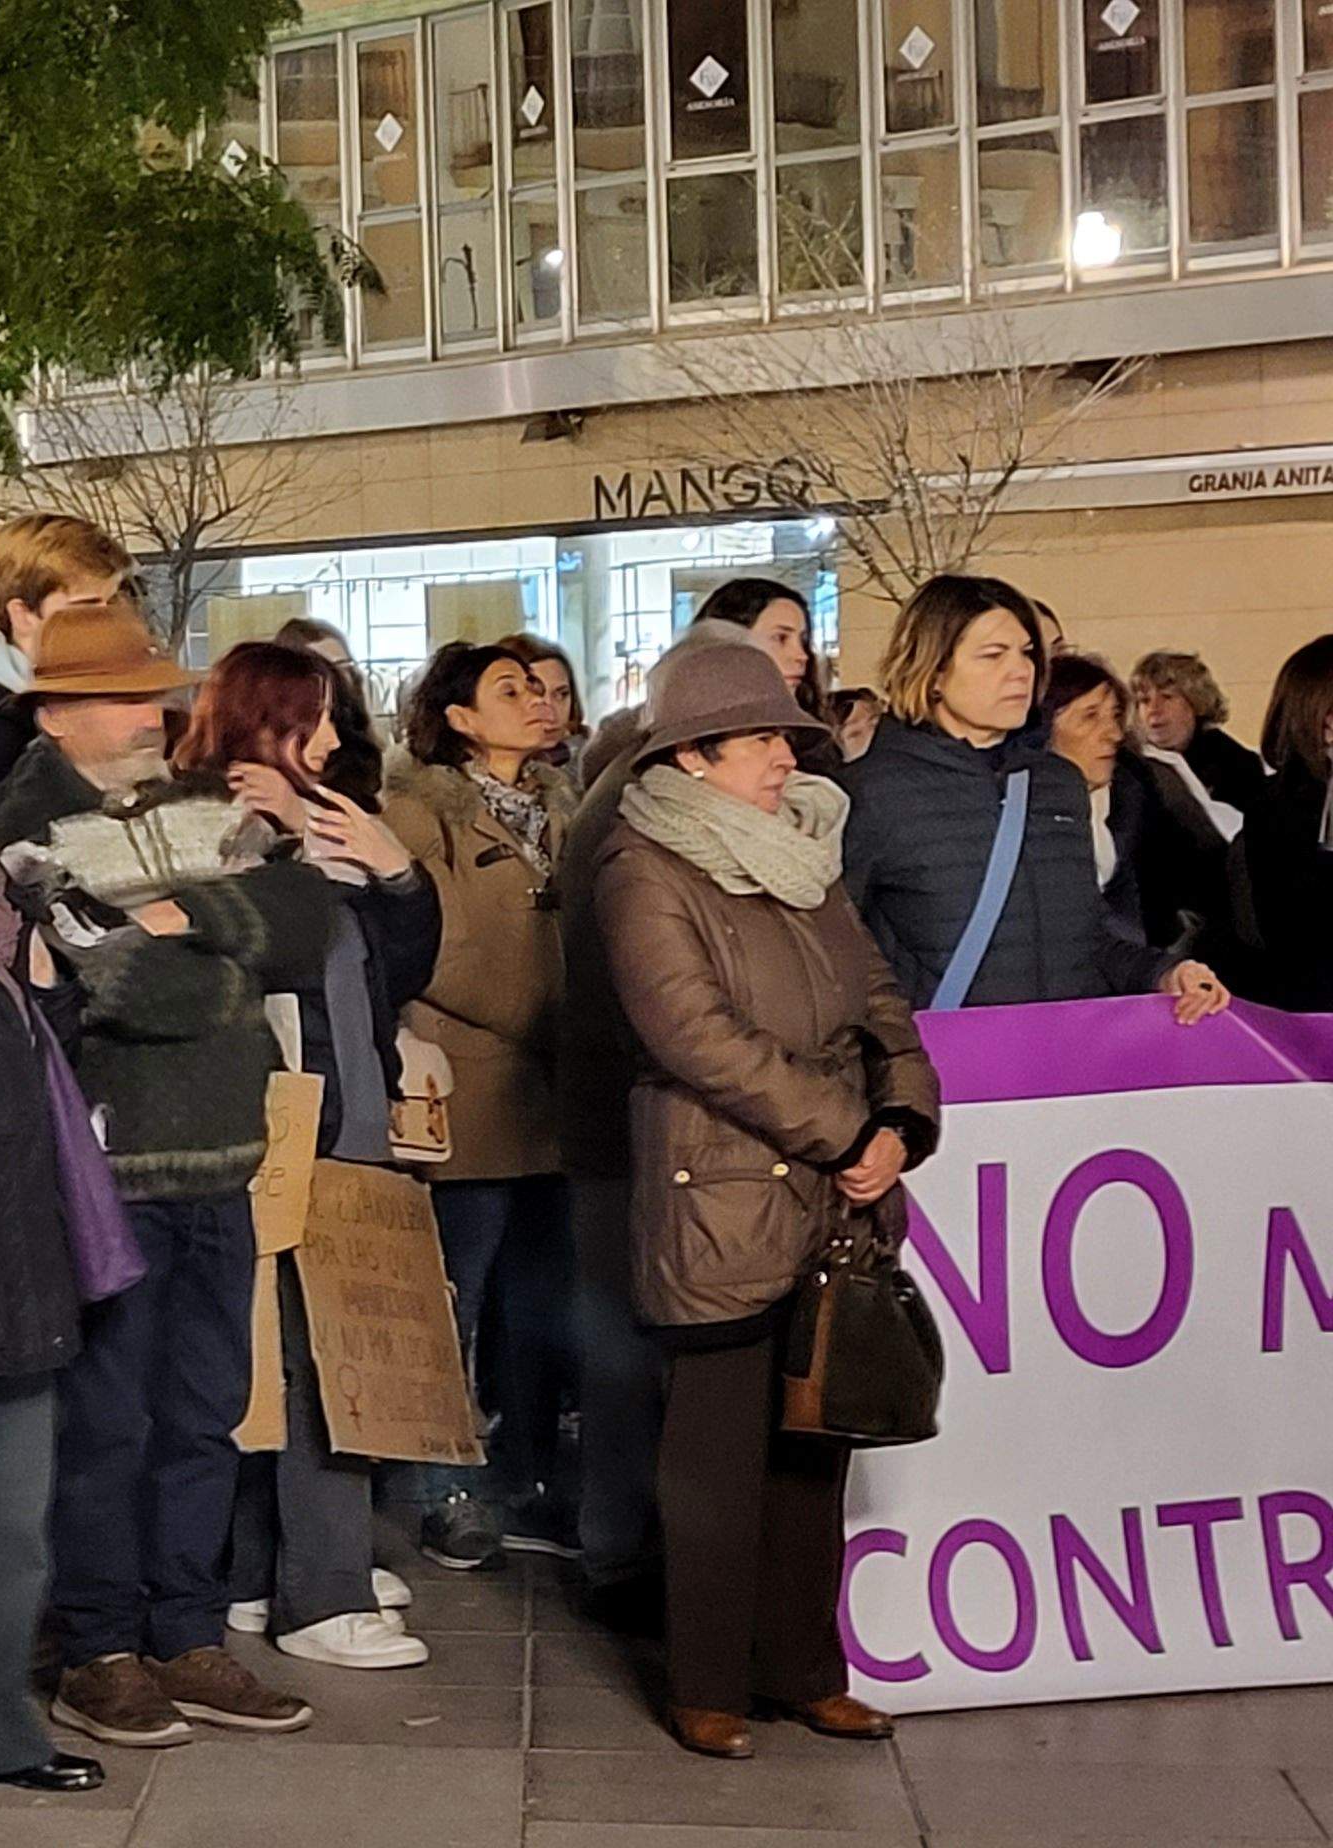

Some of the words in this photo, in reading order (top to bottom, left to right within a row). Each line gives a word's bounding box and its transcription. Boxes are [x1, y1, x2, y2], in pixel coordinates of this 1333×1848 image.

[594, 457, 811, 520] MANGO
[1189, 469, 1267, 493] GRANJA
[1273, 465, 1333, 488] ANITA
[901, 1149, 1194, 1375] NO
[836, 1490, 1333, 1683] CONTR
